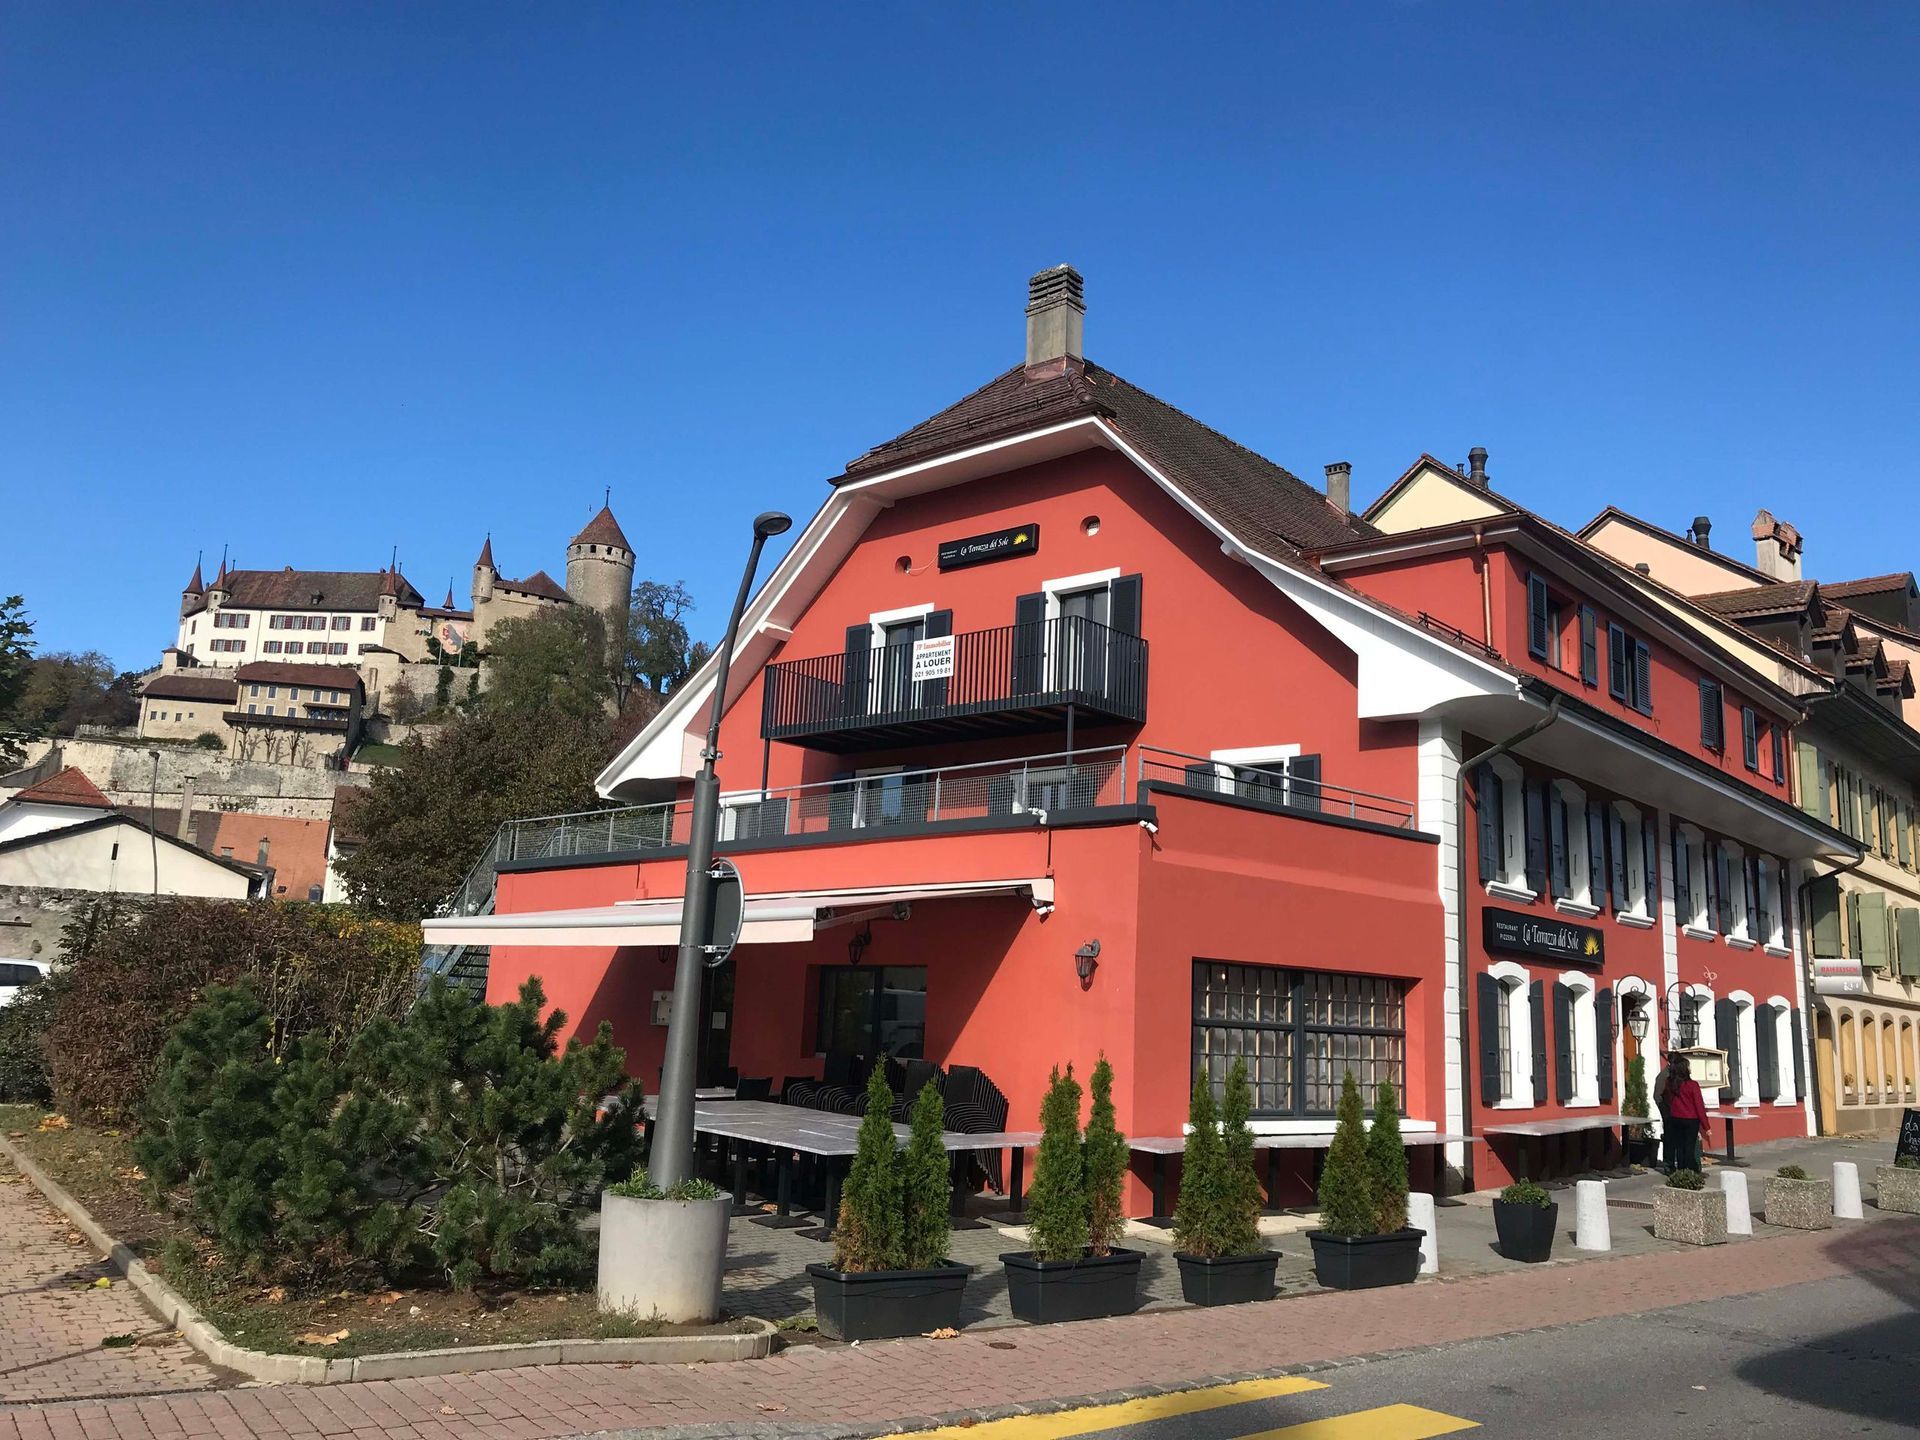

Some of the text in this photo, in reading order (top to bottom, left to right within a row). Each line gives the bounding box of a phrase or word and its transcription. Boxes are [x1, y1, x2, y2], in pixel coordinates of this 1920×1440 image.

[960, 546, 967, 556] La
[916, 649, 951, 659] APPARTEMENT
[916, 656, 951, 669] A LOUER
[925, 669, 935, 677] 905
[1496, 922, 1519, 932] RESTAURANT
[1499, 933, 1517, 942] PIZZERIA
[1522, 923, 1531, 946] La
[1558, 927, 1567, 948] del
[1567, 930, 1579, 950] Sole
